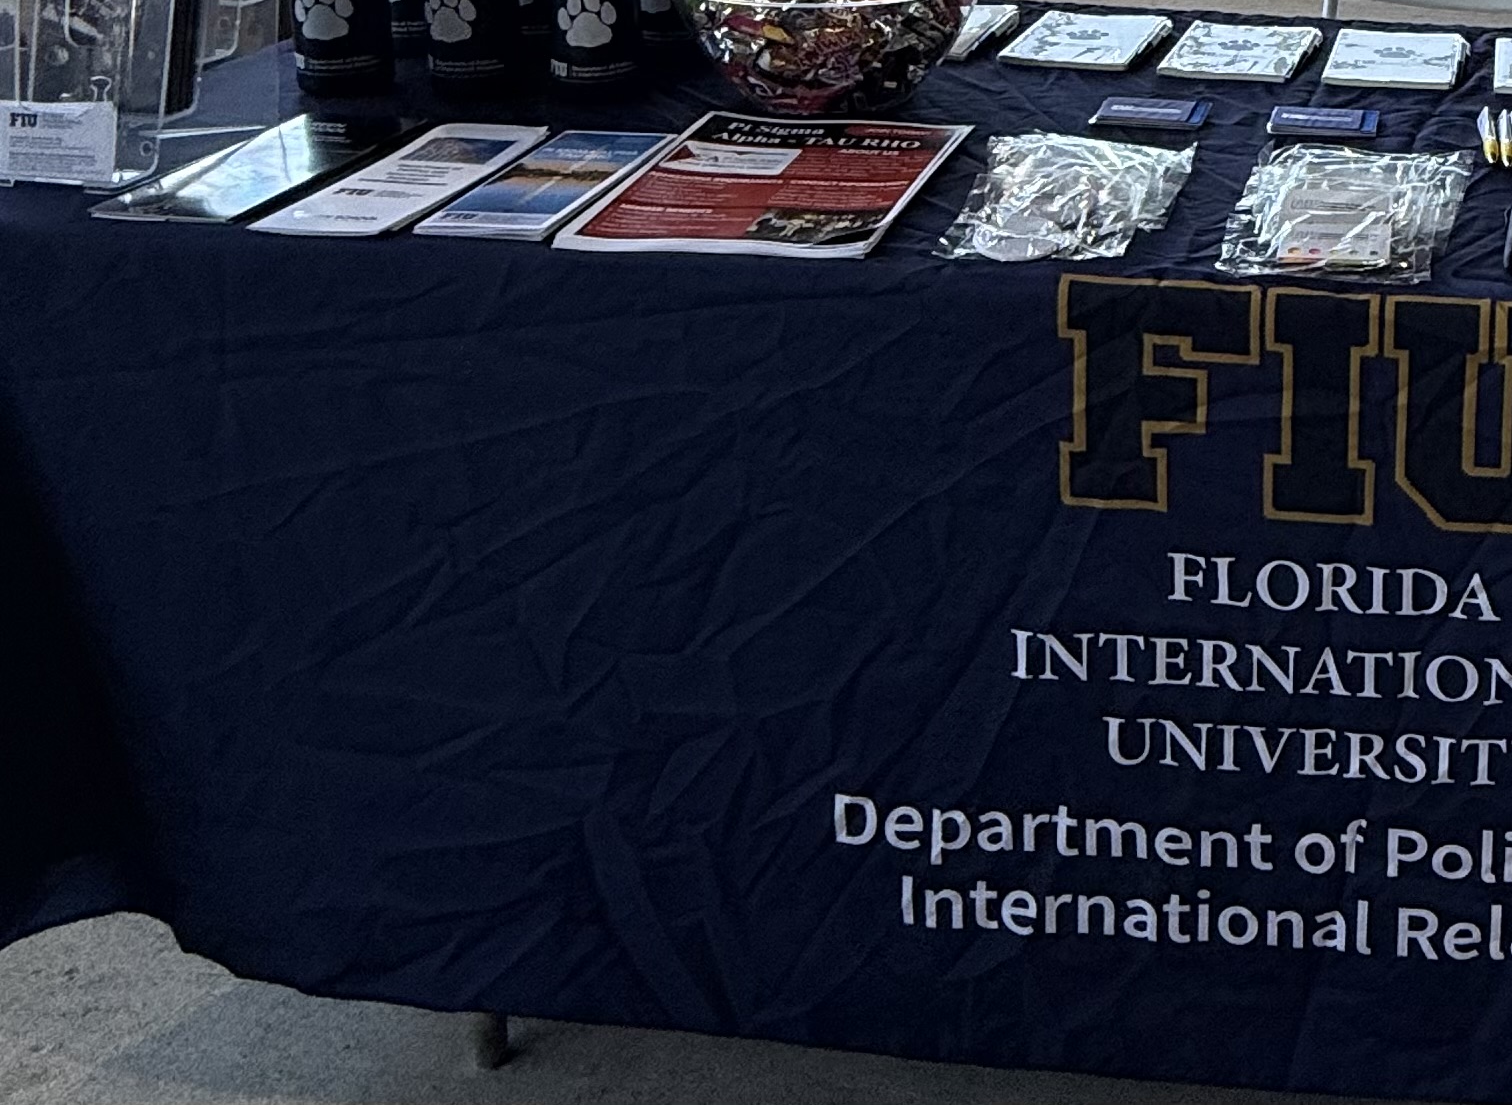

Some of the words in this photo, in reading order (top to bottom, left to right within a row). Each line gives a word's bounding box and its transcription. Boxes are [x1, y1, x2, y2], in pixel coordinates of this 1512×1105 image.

[9, 112, 38, 128] FIU
[711, 132, 781, 144] Alpha
[802, 136, 856, 146] TAU
[859, 139, 921, 149] RHO
[760, 125, 825, 137] Sigma
[1167, 551, 1501, 621] FLORIDA
[833, 793, 1274, 871] Department
[1294, 818, 1367, 875] of
[900, 874, 1372, 955] International
